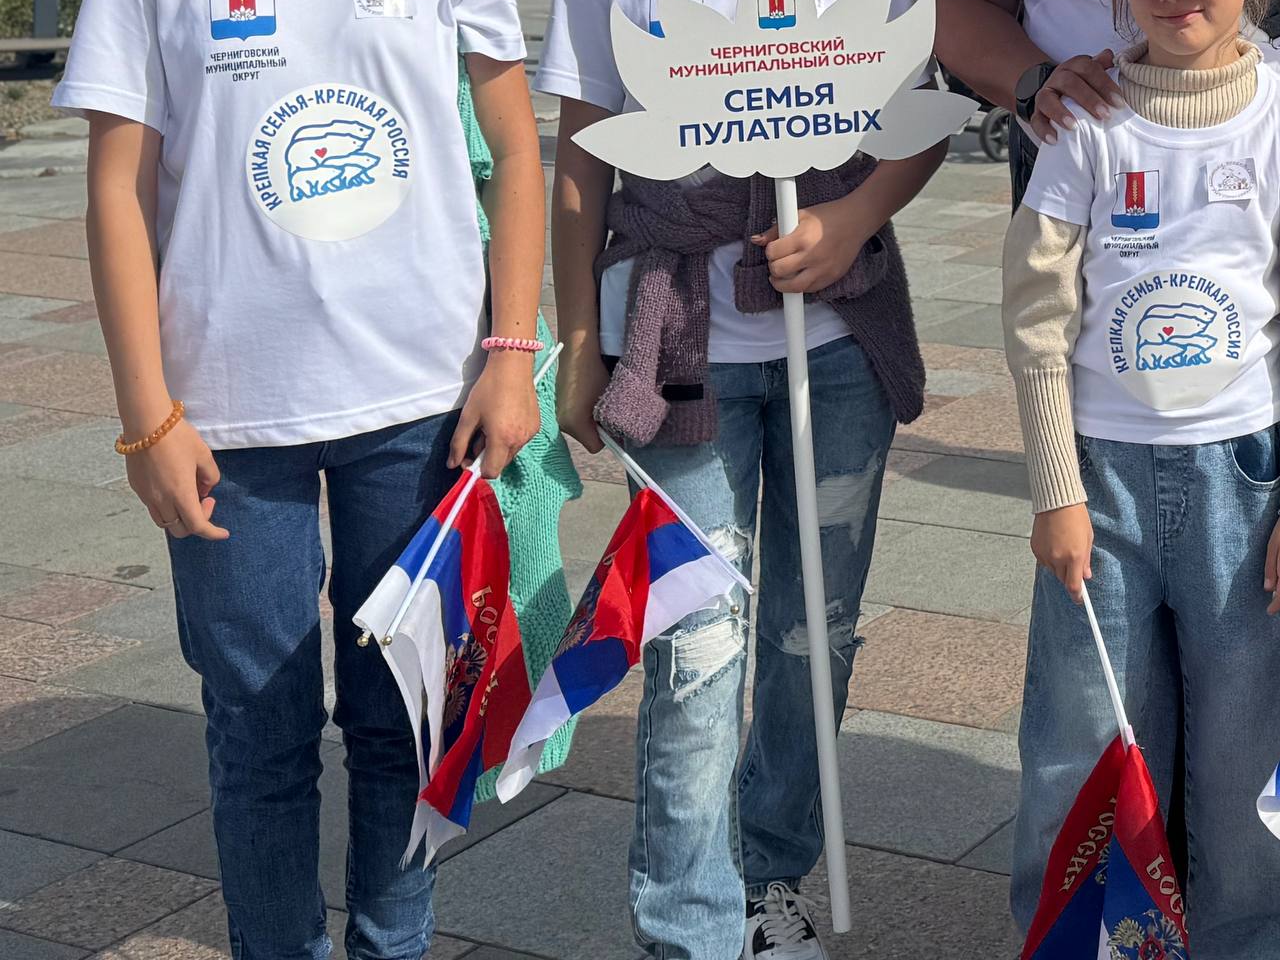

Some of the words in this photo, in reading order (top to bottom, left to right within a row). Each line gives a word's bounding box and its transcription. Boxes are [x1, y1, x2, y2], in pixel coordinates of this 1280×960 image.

[210, 47, 280, 62] ЧЕРНИГОВСКИЙ
[710, 36, 845, 60] ЧЕРНИГОВСКИЙ
[205, 58, 287, 75] МУНИЦИПАЛЬНЫЙ
[232, 71, 260, 82] ОКРУГ
[669, 53, 830, 78] МУНИЦИПАЛЬНЫЙ
[833, 50, 886, 67] ОКРУГ
[724, 83, 835, 113] СЕМЬЯ
[679, 108, 883, 148] ПУЛАТОВЫХ
[251, 139, 283, 211] КРЕПКАЯ
[381, 118, 410, 180] РОССИЯ
[1109, 308, 1130, 374] КРЕПКАЯ
[1223, 303, 1241, 360] РОССИЯ
